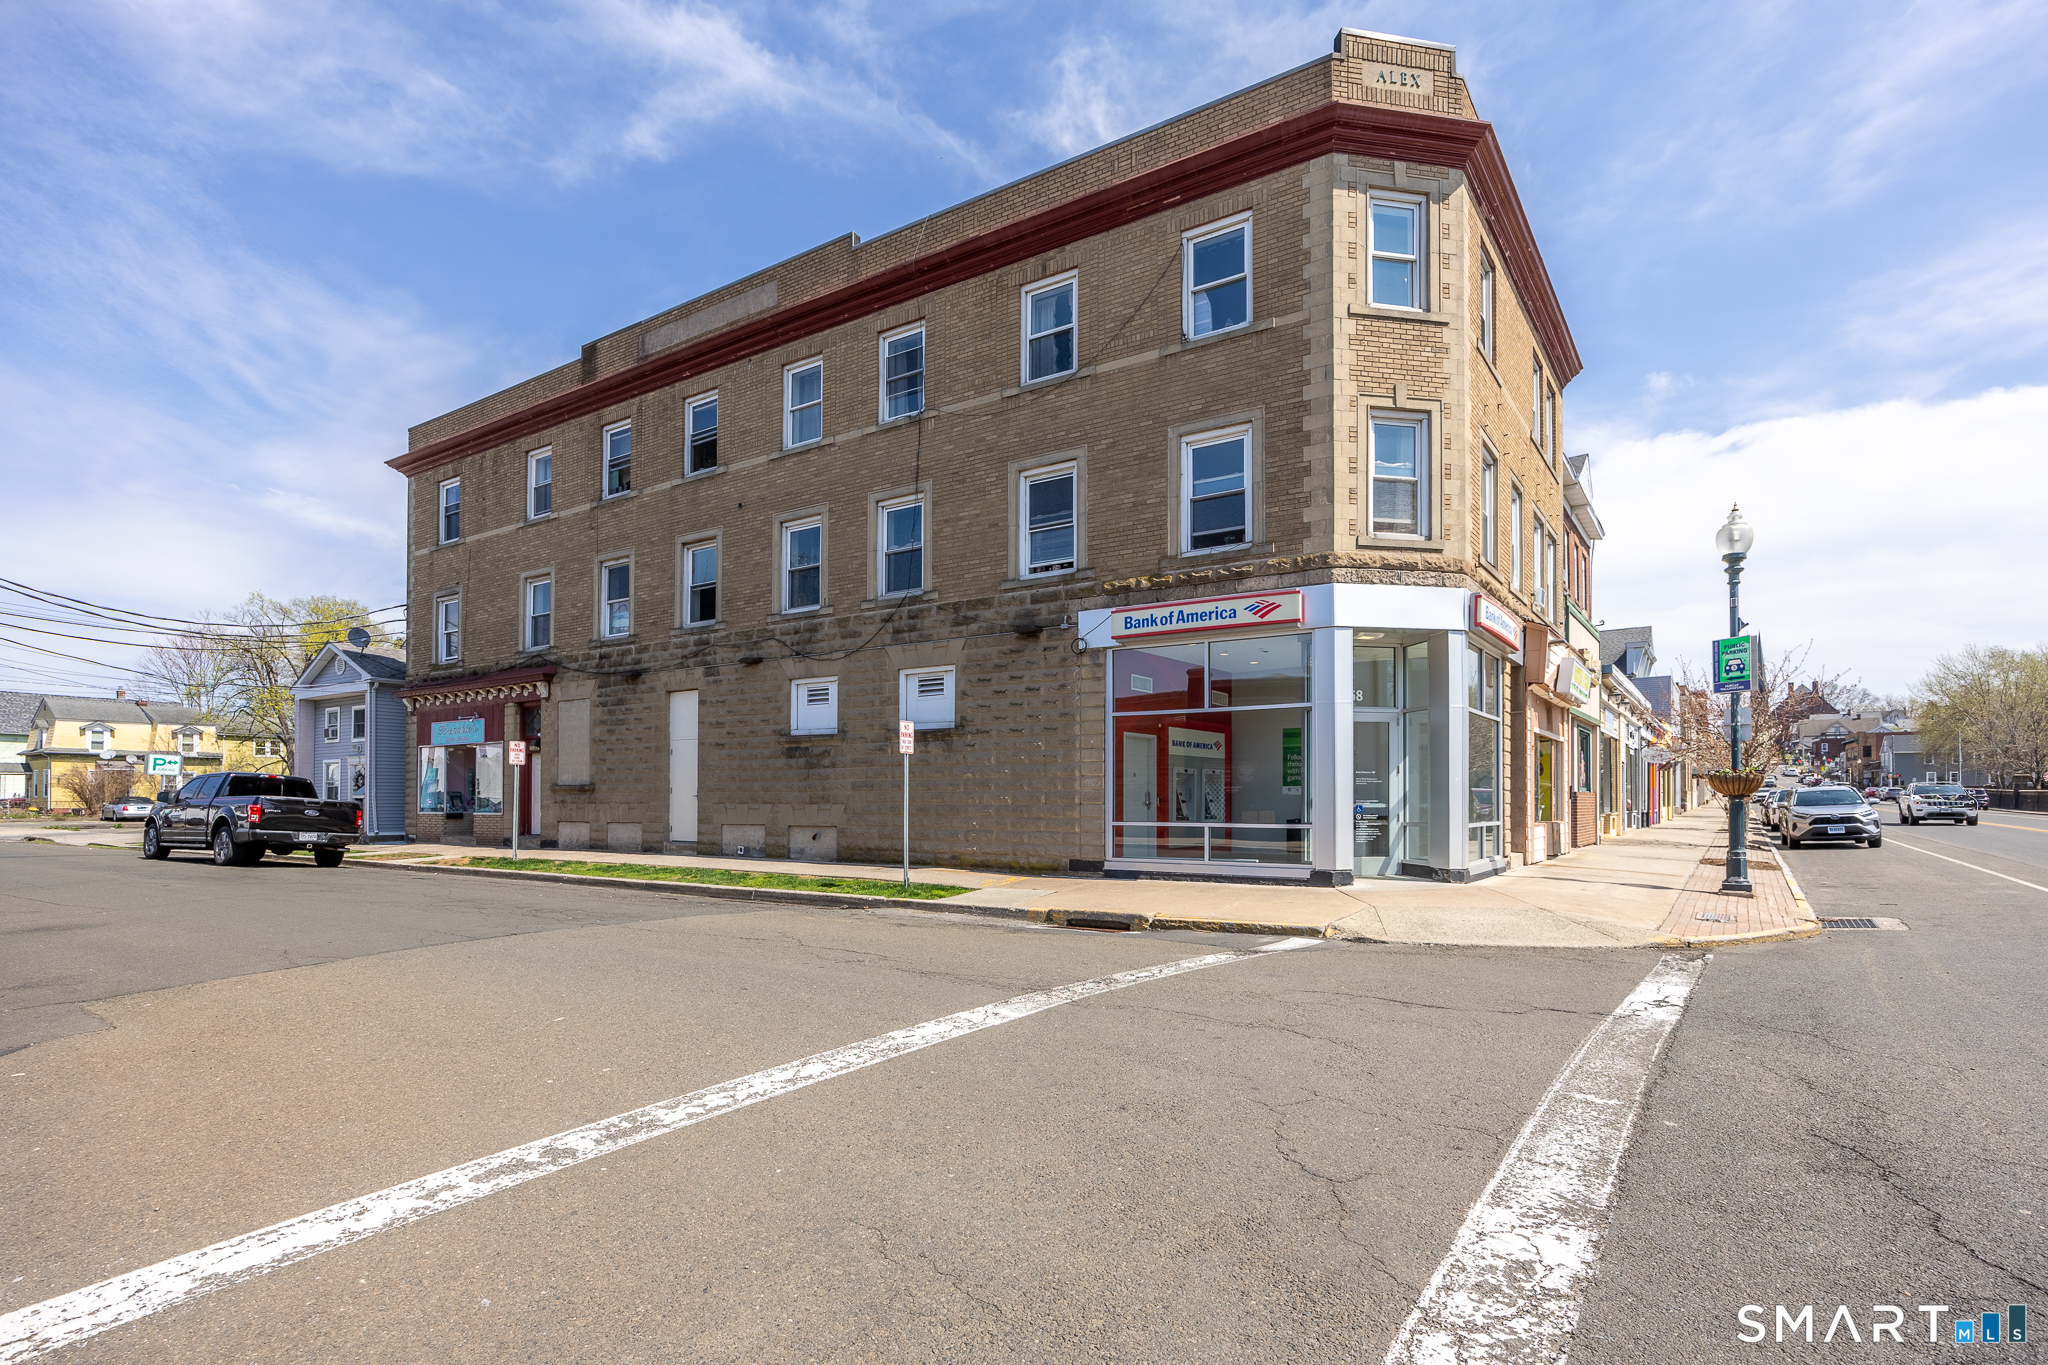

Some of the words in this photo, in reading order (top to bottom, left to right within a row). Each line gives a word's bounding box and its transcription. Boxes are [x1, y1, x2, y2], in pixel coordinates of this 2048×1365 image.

[1376, 70, 1420, 88] ALEX
[1124, 613, 1158, 630] Bank
[1160, 611, 1175, 626] of
[1175, 606, 1237, 624] America
[1722, 648, 1747, 656] PARKING
[1172, 740, 1186, 748] BANK
[1193, 742, 1213, 750] AMERICA
